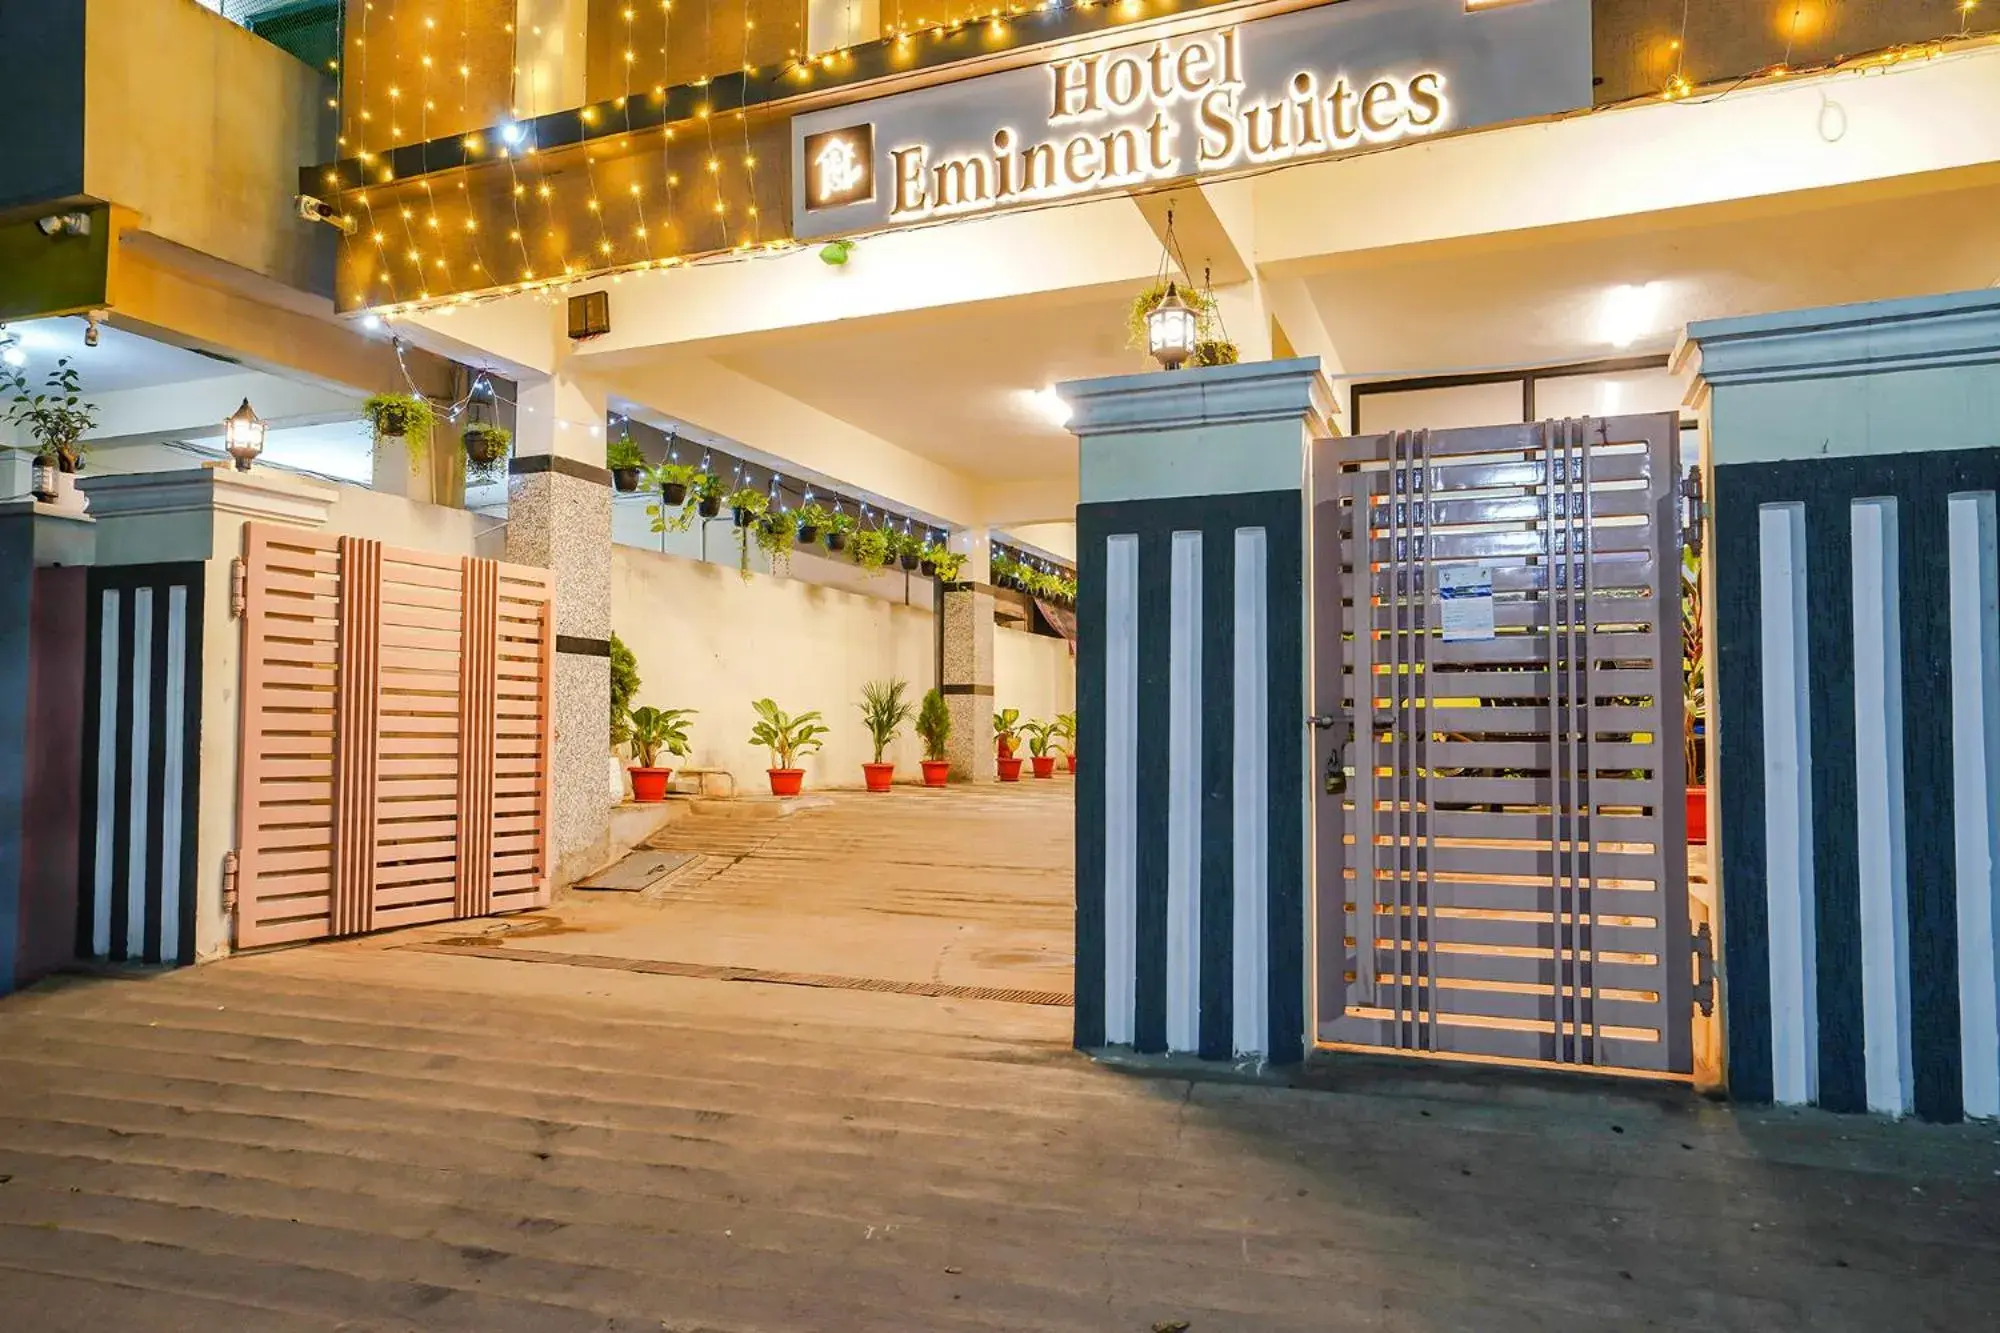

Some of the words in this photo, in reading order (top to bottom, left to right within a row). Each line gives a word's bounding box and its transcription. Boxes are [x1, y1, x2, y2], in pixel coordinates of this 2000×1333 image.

[1047, 25, 1242, 119] Hotel
[887, 112, 1172, 216] Eminent
[1198, 72, 1440, 162] Suites
